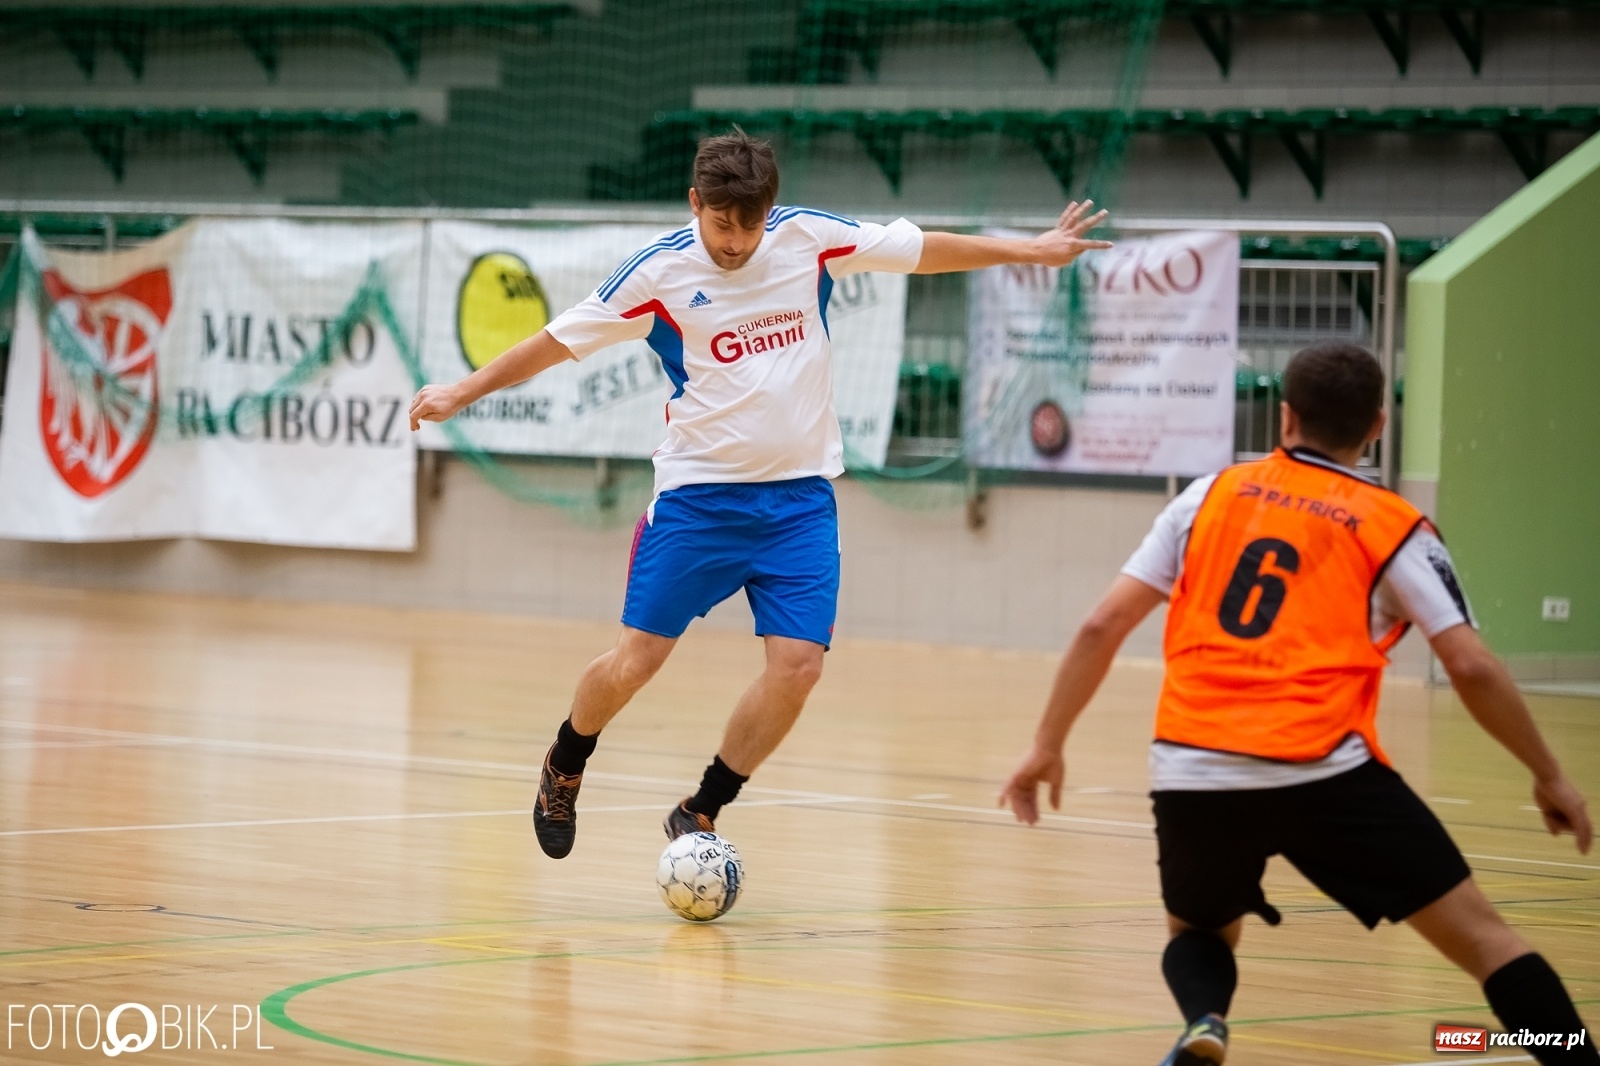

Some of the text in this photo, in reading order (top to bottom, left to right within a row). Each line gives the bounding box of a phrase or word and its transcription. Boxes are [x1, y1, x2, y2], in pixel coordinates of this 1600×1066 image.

[689, 299, 712, 309] adidas
[737, 309, 804, 335] CUKIERNIA
[202, 312, 377, 367] MIASTO
[710, 321, 805, 364] Gianni
[177, 378, 402, 448] RACIBÓRZ
[1263, 489, 1364, 532] PATRICK
[1218, 537, 1300, 639] 6
